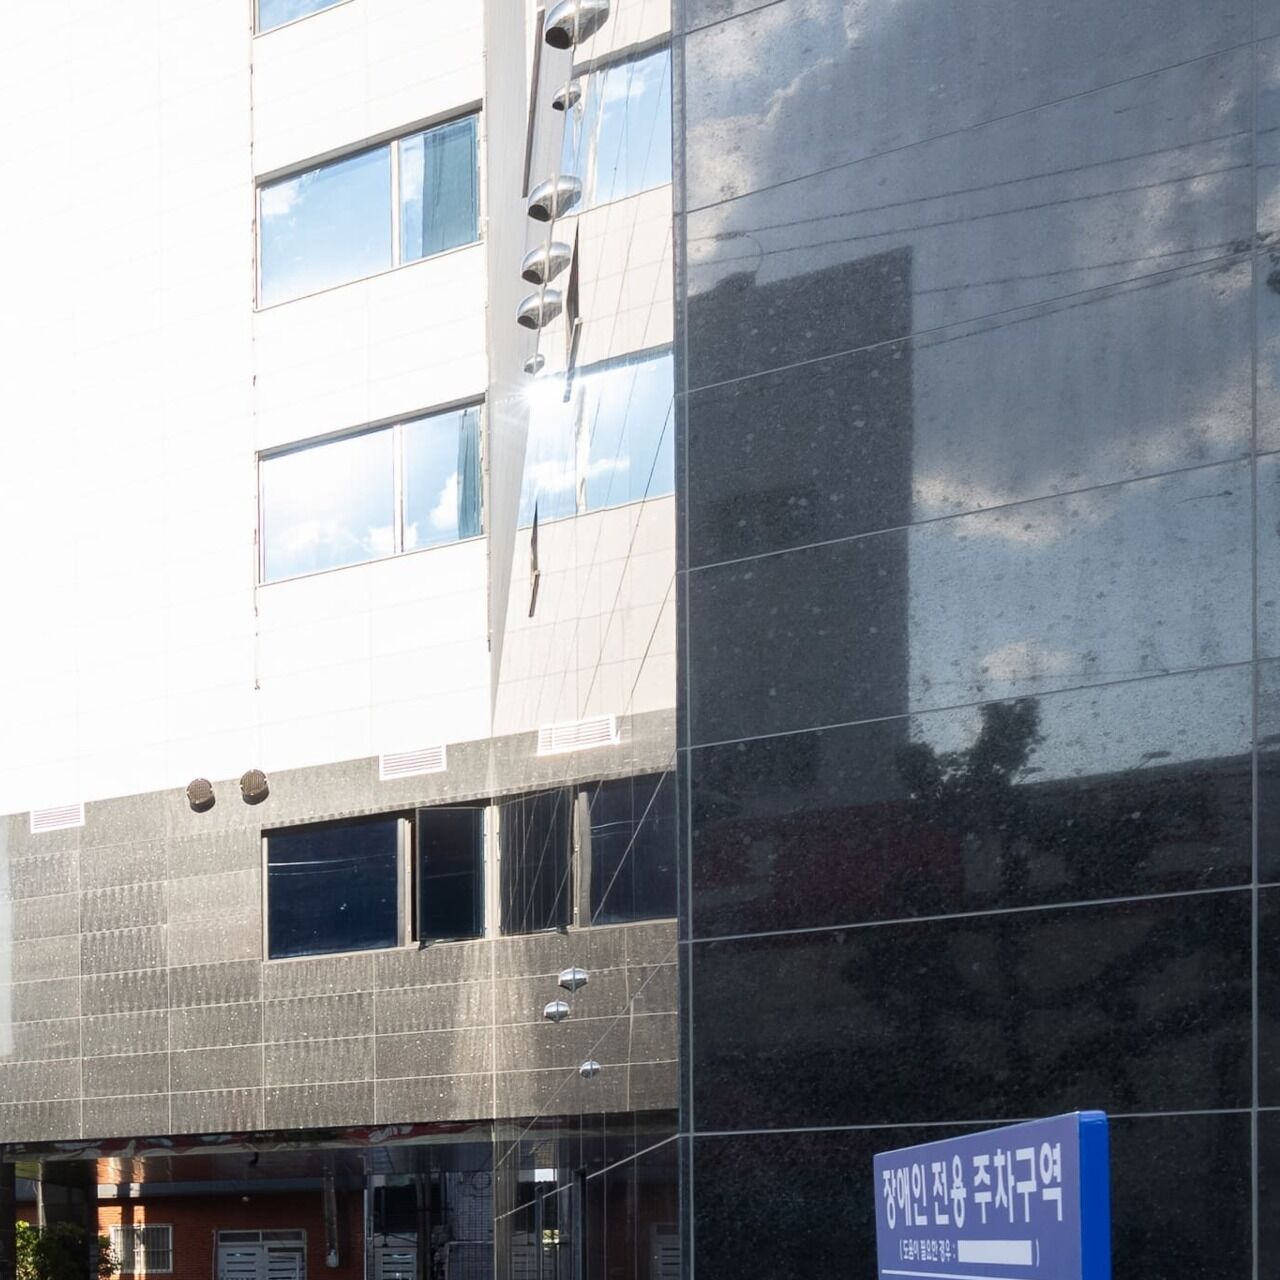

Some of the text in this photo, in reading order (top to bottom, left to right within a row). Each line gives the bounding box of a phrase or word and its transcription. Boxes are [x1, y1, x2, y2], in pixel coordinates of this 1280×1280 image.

[882, 1142, 1063, 1230] 장애인 전용 주차구역
